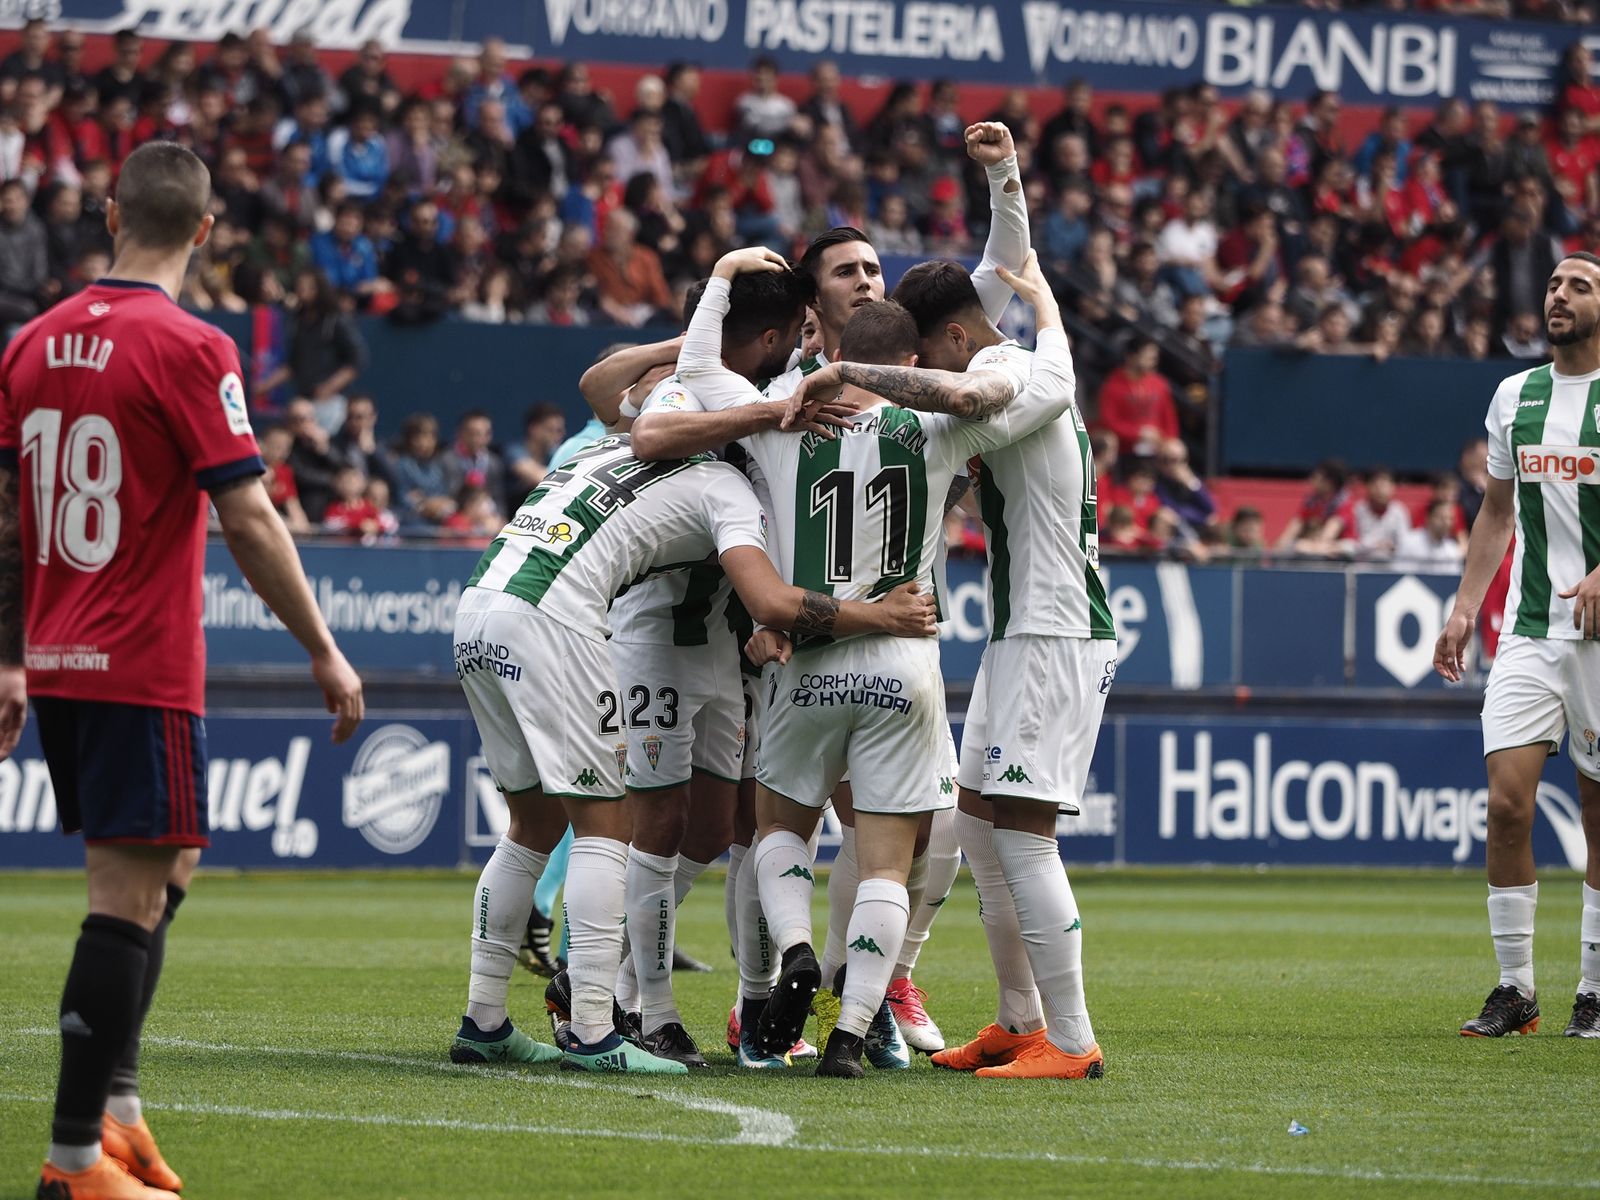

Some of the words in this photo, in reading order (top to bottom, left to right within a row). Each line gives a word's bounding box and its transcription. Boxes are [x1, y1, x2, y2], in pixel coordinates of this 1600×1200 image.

[744, 0, 1004, 61] PASTELERIA
[1205, 12, 1457, 98] BIANBI
[46, 333, 114, 373] LILLO
[1513, 399, 1545, 408] Kappa
[21, 408, 123, 573] 18
[1520, 450, 1595, 481] tango
[810, 464, 911, 585] 11
[629, 684, 679, 731] 23
[820, 690, 912, 715] HYUNDAI
[657, 899, 668, 971] CORDOBA
